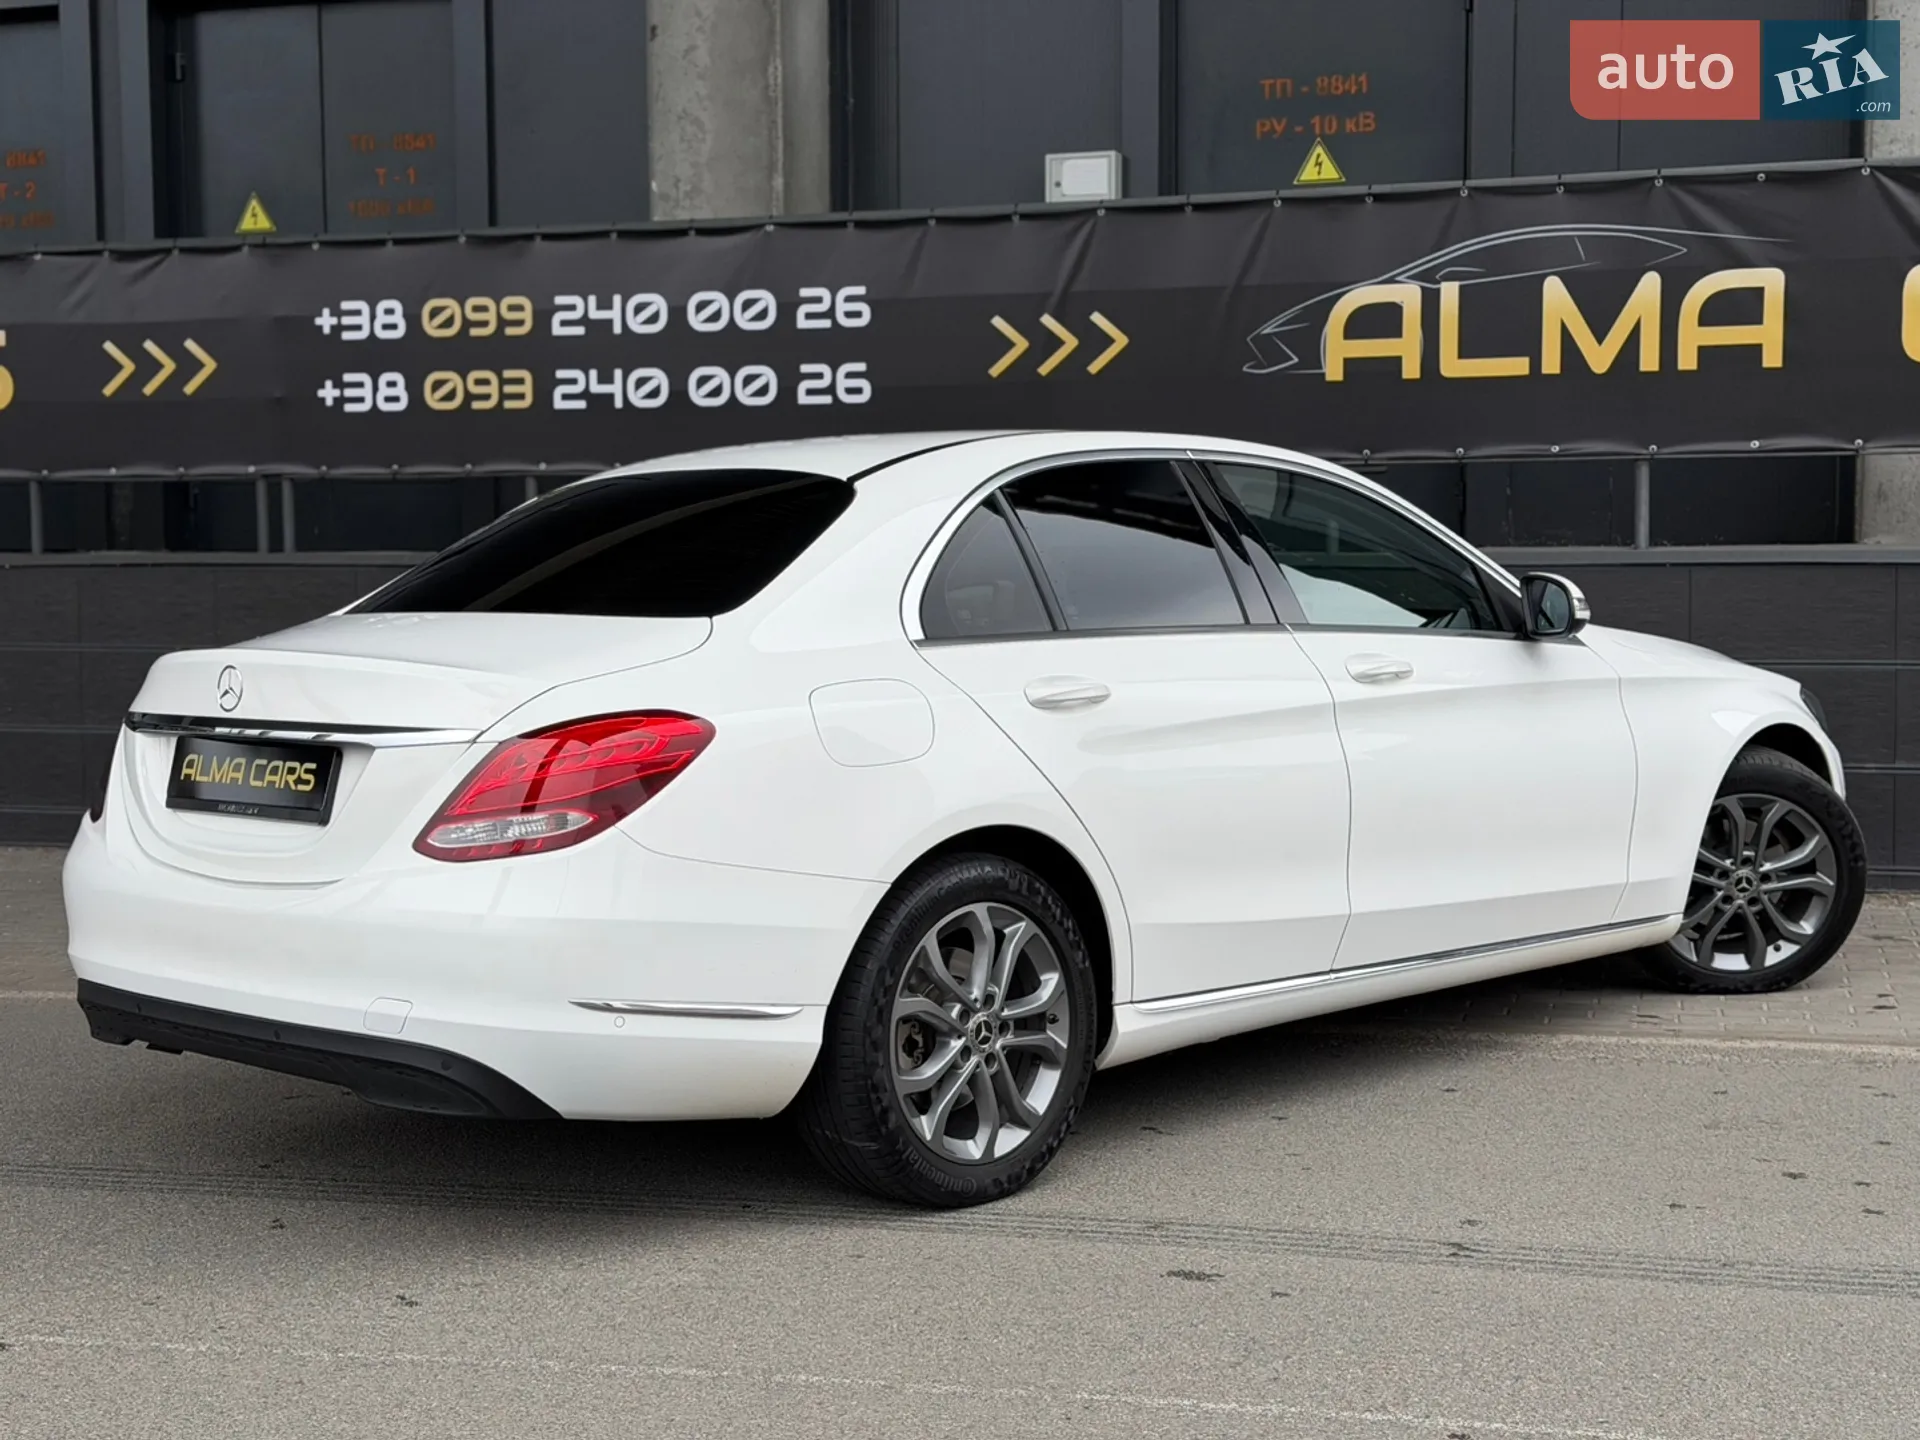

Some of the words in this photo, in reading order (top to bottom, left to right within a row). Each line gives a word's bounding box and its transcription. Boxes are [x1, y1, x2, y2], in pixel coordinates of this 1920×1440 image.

[1316, 72, 1369, 96] 8841
[1310, 114, 1339, 136] 10
[406, 165, 418, 185] 1
[315, 298, 407, 341] +38
[421, 295, 533, 338] 099
[551, 292, 669, 336] 240
[687, 288, 777, 333] 00
[796, 285, 872, 330] 26
[1325, 267, 1786, 382] ALMA
[316, 371, 409, 413] +38
[423, 368, 533, 410] 093
[552, 367, 670, 410] 240
[687, 364, 778, 407] 00
[797, 361, 872, 405] 26
[181, 754, 246, 785] ALMA
[250, 759, 317, 791] CARS
